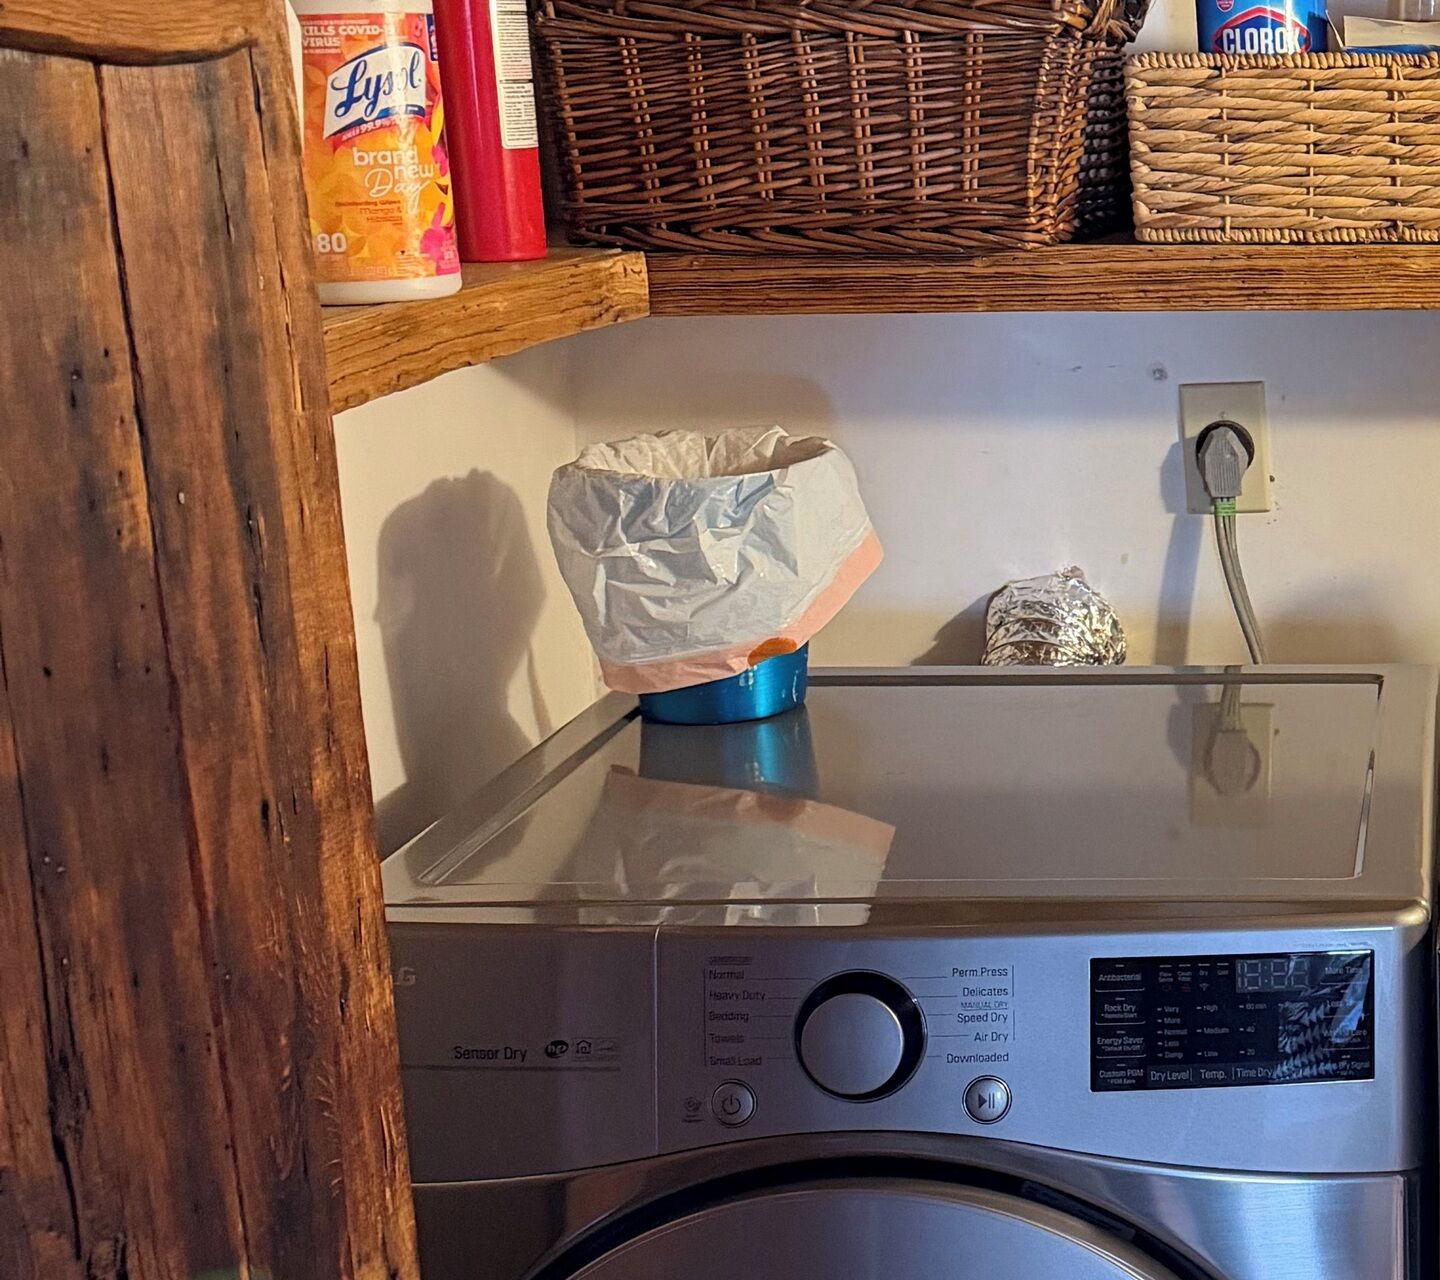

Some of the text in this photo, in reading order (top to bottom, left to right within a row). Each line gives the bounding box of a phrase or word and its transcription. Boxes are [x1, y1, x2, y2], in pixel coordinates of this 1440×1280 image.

[1222, 26, 1302, 56] CLOROX
[352, 145, 419, 167] brand
[394, 163, 434, 179] new
[364, 167, 431, 216] Day
[316, 232, 348, 254] 80
[709, 970, 745, 980] Normal
[980, 967, 1008, 977] Press
[709, 990, 766, 1001] Heavy Duty
[962, 987, 1009, 997] Delicates
[1122, 1004, 1137, 1013] Dry
[709, 1010, 750, 1023] Bedding
[957, 1012, 1008, 1025] Speed Dry
[709, 1033, 745, 1044] Towels
[974, 1031, 1009, 1043] Air Dry
[1096, 1036, 1144, 1045] Energy Saver
[453, 1046, 528, 1063] Sensor Dry
[709, 1055, 762, 1066] Small Load
[946, 1052, 1009, 1064] Downloaded
[1150, 1070, 1190, 1082] Dry Level
[1200, 1069, 1227, 1080] Temp.
[1235, 1067, 1273, 1079] Time Dry
